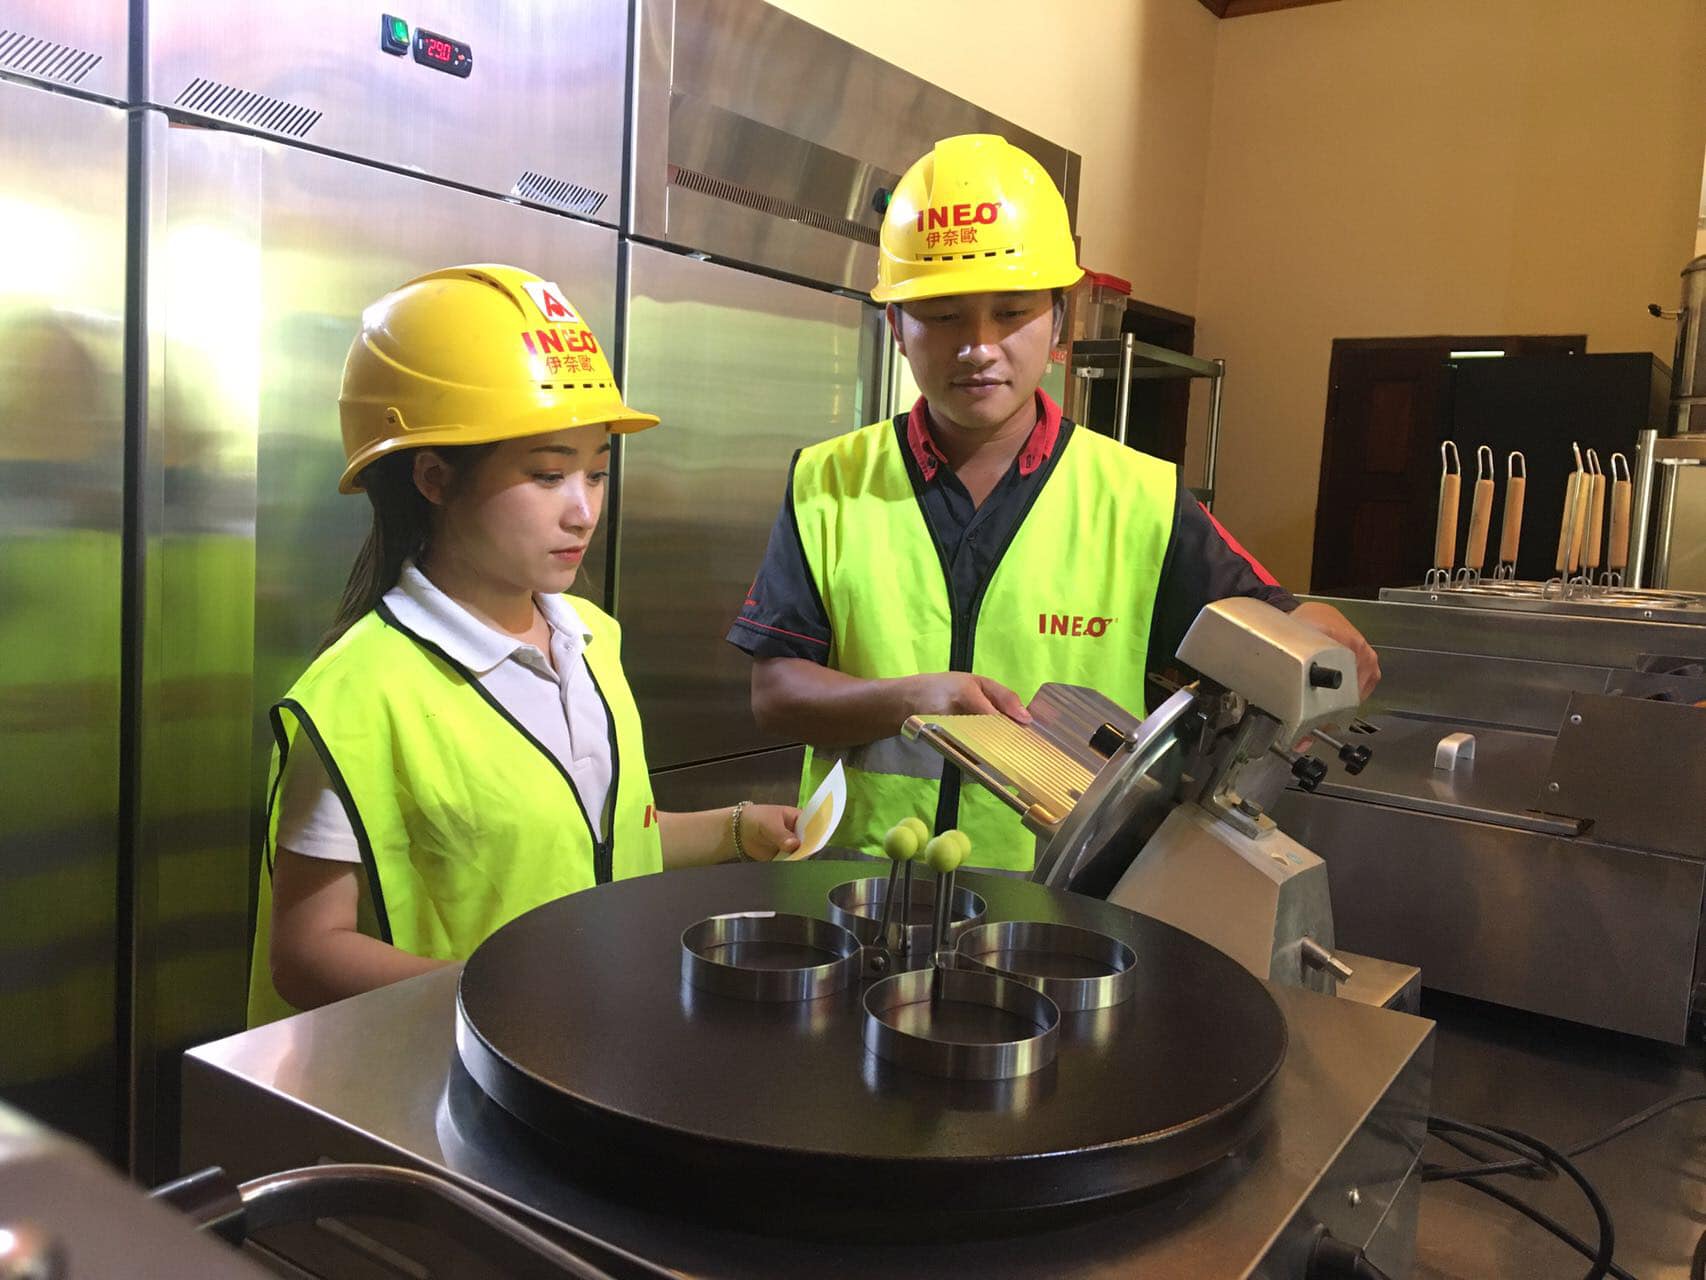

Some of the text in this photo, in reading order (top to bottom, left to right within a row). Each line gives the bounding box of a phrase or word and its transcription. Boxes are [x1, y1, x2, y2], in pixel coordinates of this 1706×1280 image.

[917, 202, 1001, 232] INEO
[926, 226, 978, 249] 伊奈歐
[521, 329, 597, 354] INEO
[1039, 613, 1113, 637] INEO
